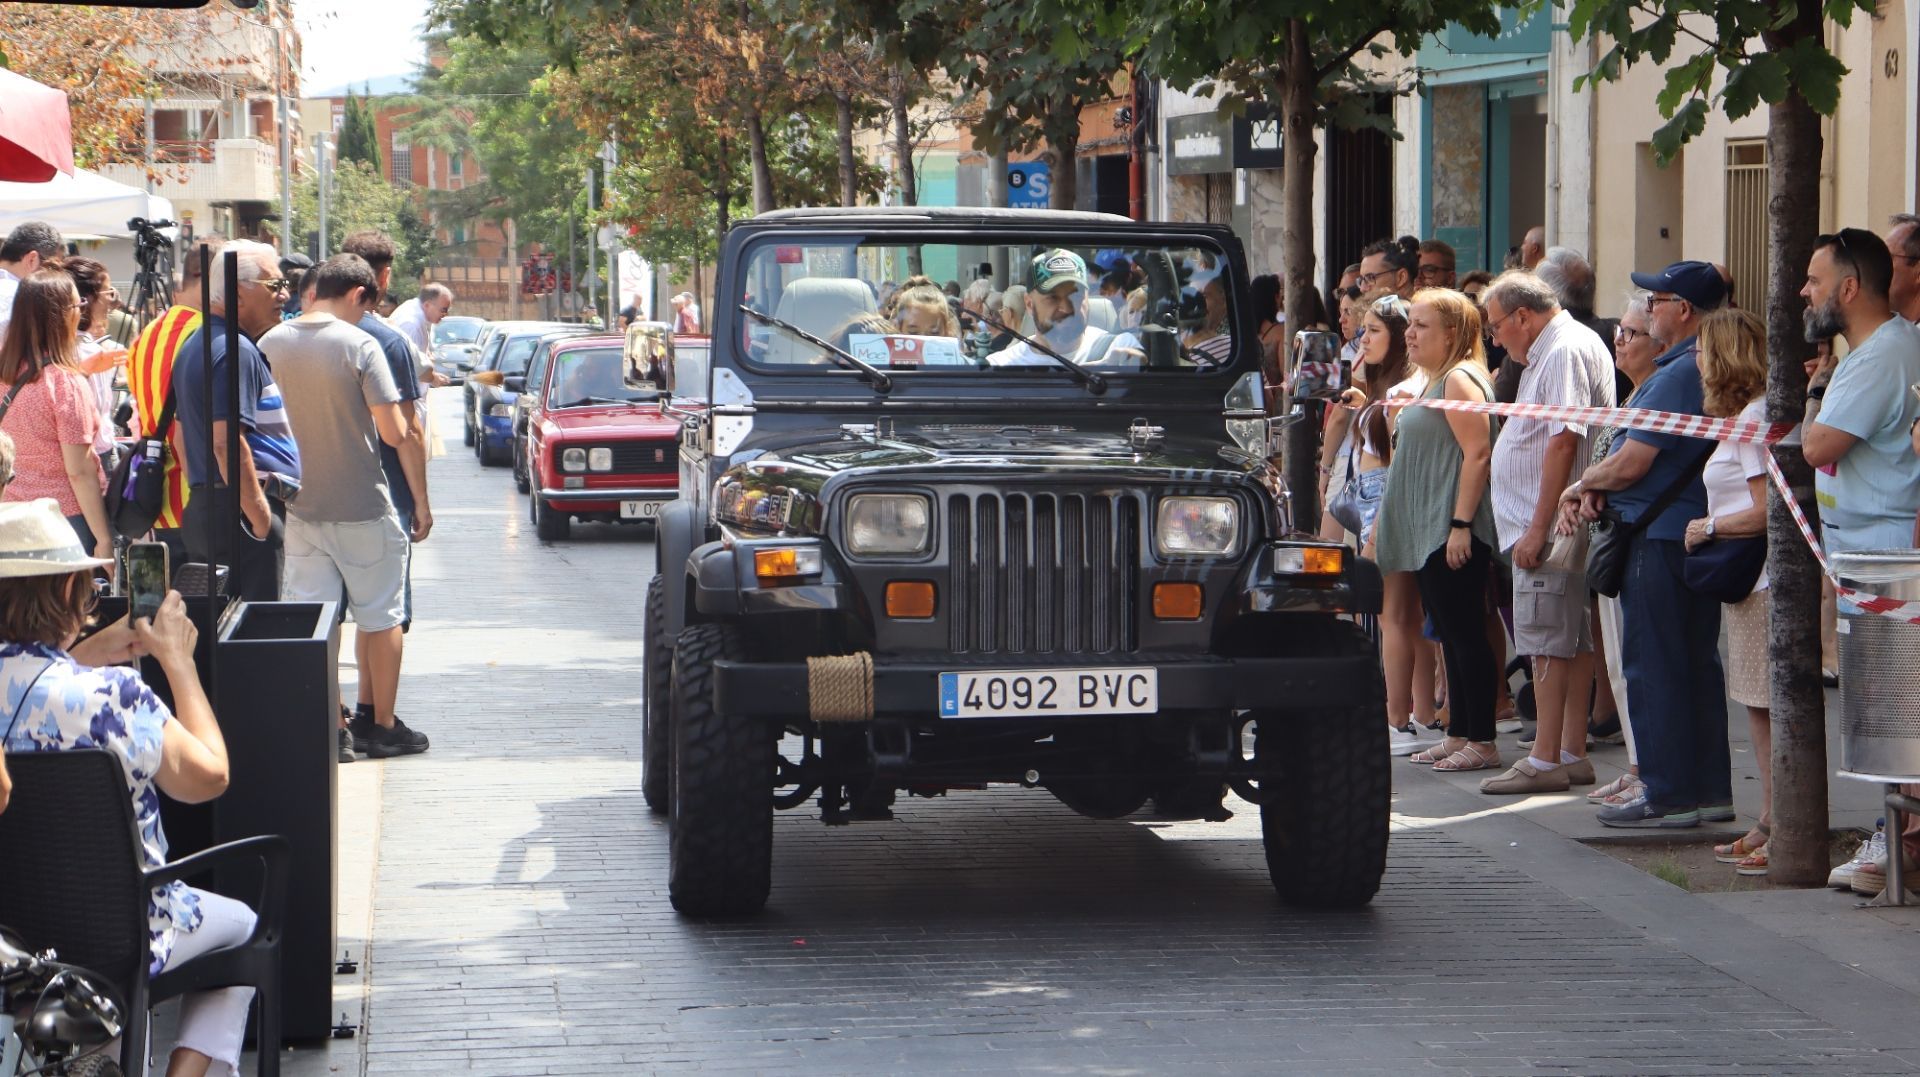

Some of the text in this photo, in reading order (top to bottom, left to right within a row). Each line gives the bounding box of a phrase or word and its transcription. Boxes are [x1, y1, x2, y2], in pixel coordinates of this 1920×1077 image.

[1885, 48, 1898, 78] 63
[1028, 172, 1047, 198] S
[894, 339, 916, 352] 50
[629, 503, 664, 516] V 07
[963, 674, 1148, 711] 4092 BVC
[945, 700, 954, 710] E
